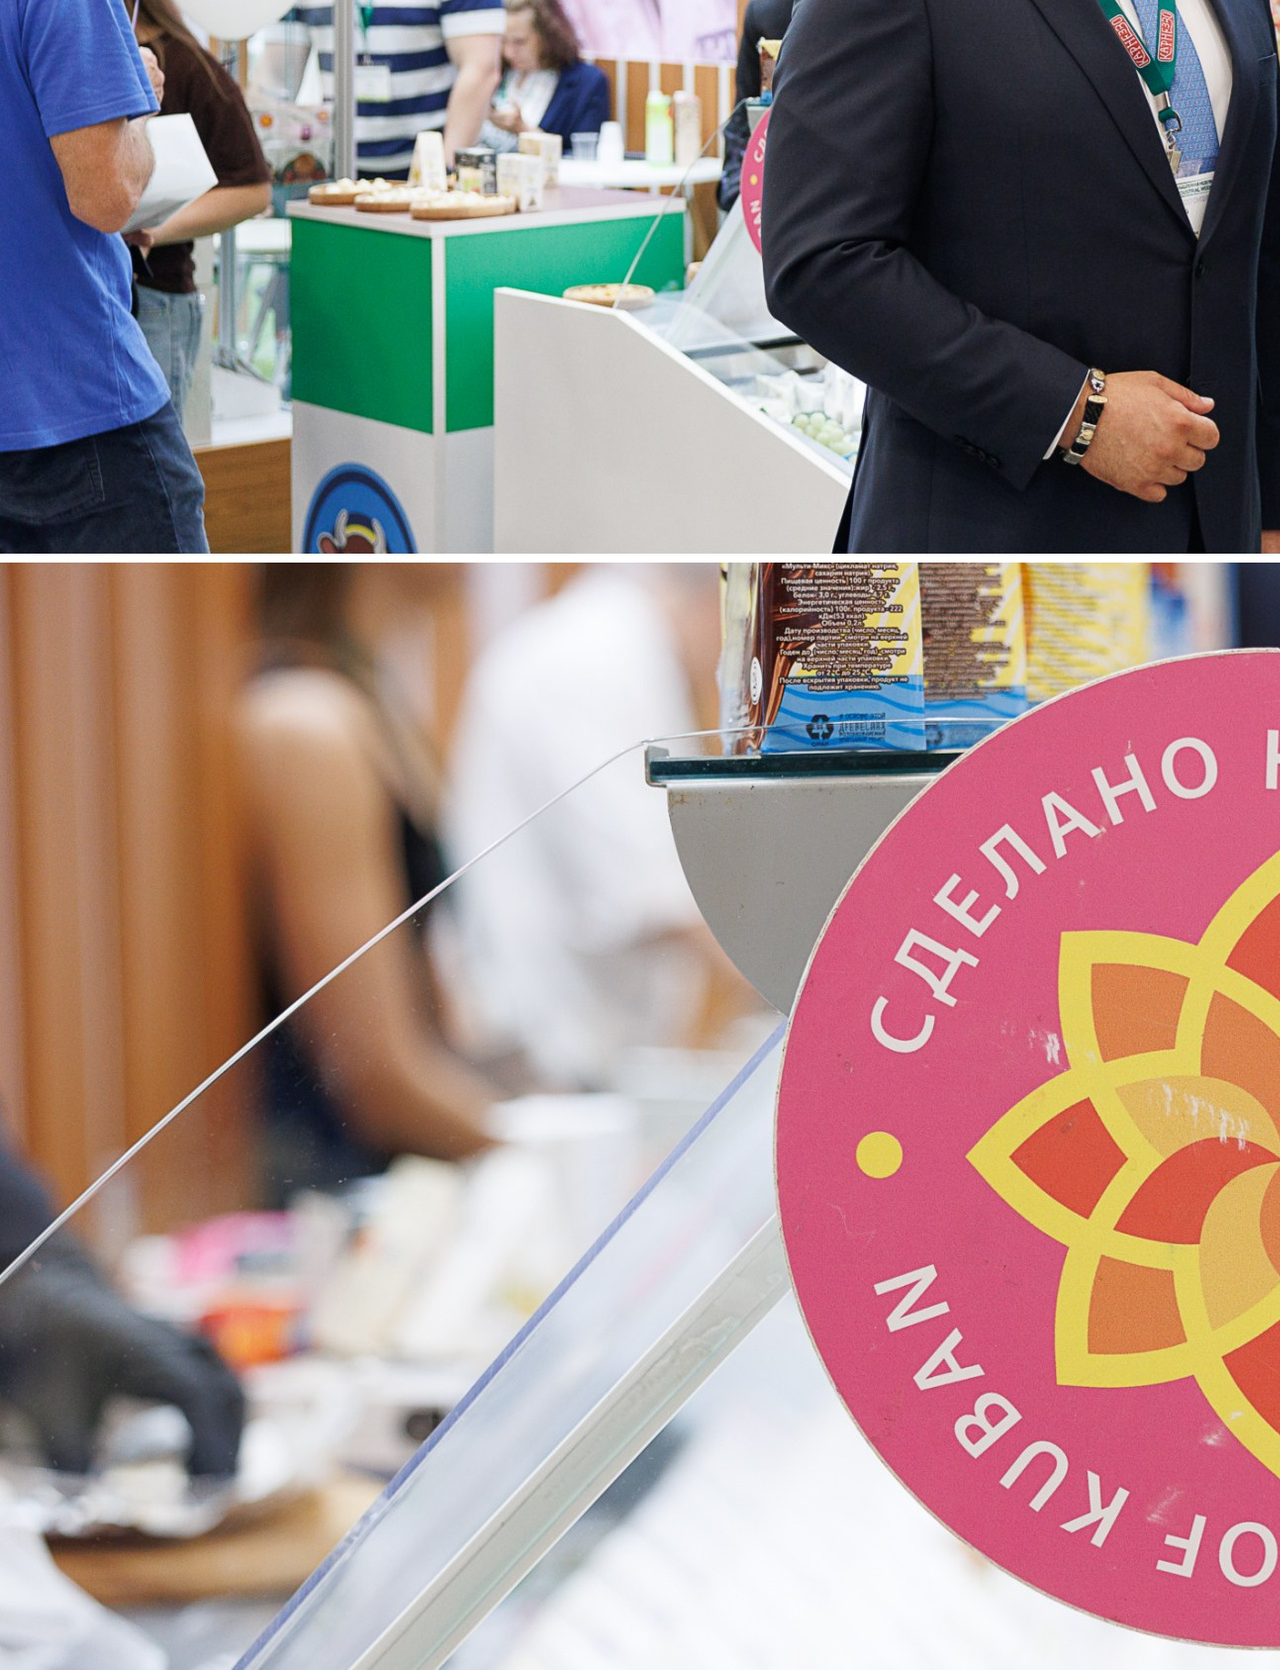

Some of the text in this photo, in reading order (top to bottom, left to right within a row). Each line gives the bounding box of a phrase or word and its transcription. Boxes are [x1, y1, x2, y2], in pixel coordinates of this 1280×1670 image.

[870, 736, 1218, 1054] СДЕЛАНО
[873, 1263, 1131, 1548] KUBAN
[1155, 1514, 1279, 1588] OF
